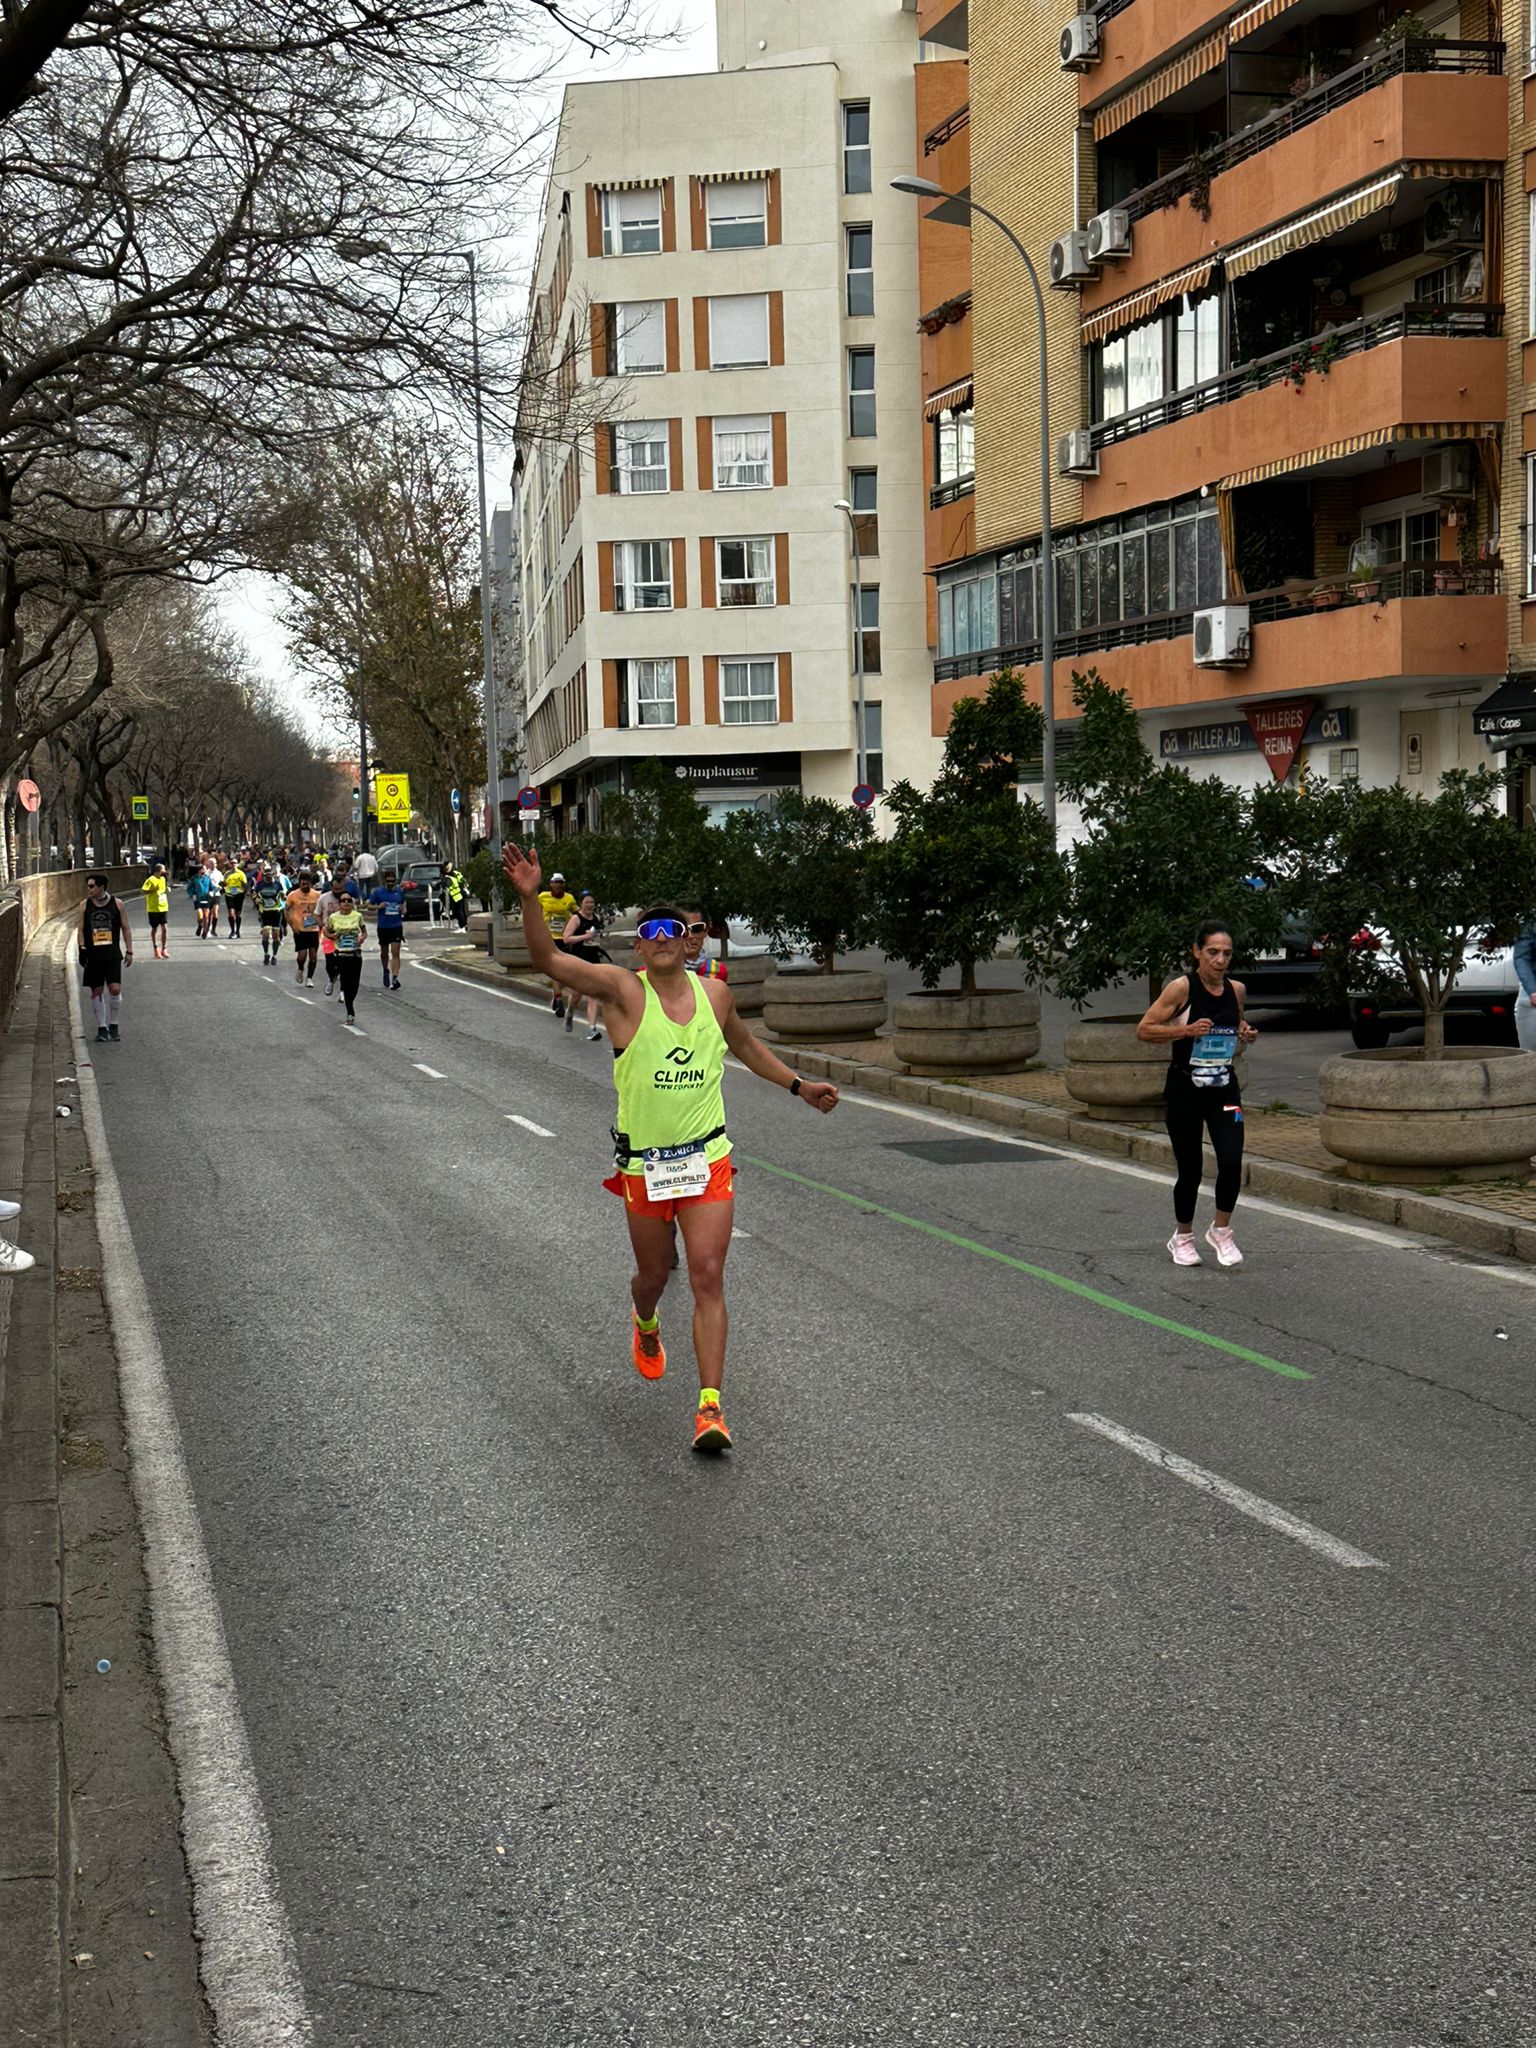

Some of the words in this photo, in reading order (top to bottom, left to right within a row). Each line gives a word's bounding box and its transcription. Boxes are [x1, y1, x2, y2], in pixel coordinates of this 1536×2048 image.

[1255, 709, 1303, 731] TALLERES
[1187, 731, 1223, 750] TALLER
[1225, 726, 1240, 748] AD
[1264, 736, 1293, 755] REINA
[689, 765, 758, 779] Implansur
[654, 1069, 704, 1083] CLIPIN
